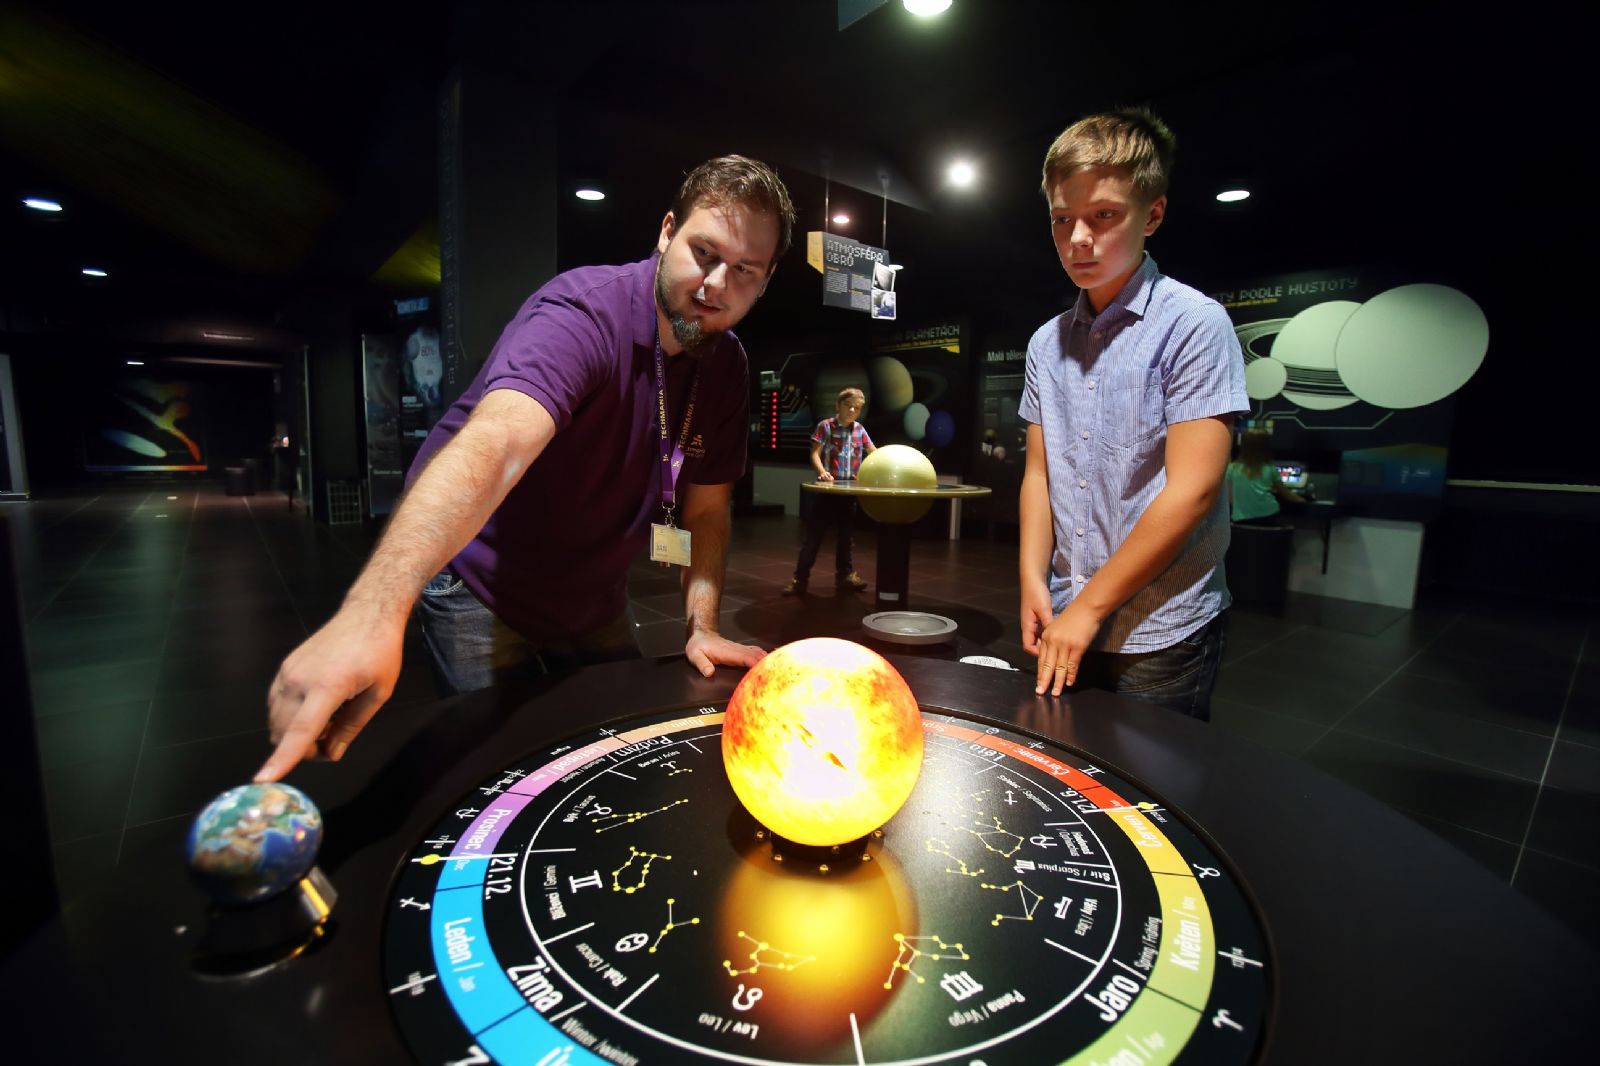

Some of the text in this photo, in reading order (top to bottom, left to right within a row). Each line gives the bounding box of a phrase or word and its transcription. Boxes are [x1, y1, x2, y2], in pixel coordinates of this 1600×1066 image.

[826, 239, 884, 264] ATMOSFÉRA
[1239, 285, 1283, 301] PODLE
[1288, 276, 1359, 296] HUSTOTY
[1006, 349, 1026, 361] těles
[659, 389, 668, 440] TECHMANIA
[678, 403, 694, 449] TECHMANIA
[614, 736, 673, 757] Podzim
[1060, 787, 1098, 811] 21.6.
[464, 808, 512, 850] Prosinec
[485, 857, 516, 900] 21.12.
[1038, 863, 1081, 877] Scorpius
[444, 917, 476, 965] Leden
[1168, 919, 1201, 972] Květen
[576, 942, 604, 969] Cancer
[506, 955, 563, 1013] Zima
[602, 966, 627, 988] Rak
[986, 988, 1026, 1013] Panna
[1083, 974, 1140, 1022] Jaro
[698, 1012, 723, 1031] Leo
[732, 1021, 760, 1040] Lev
[948, 1008, 984, 1028] Virgo
